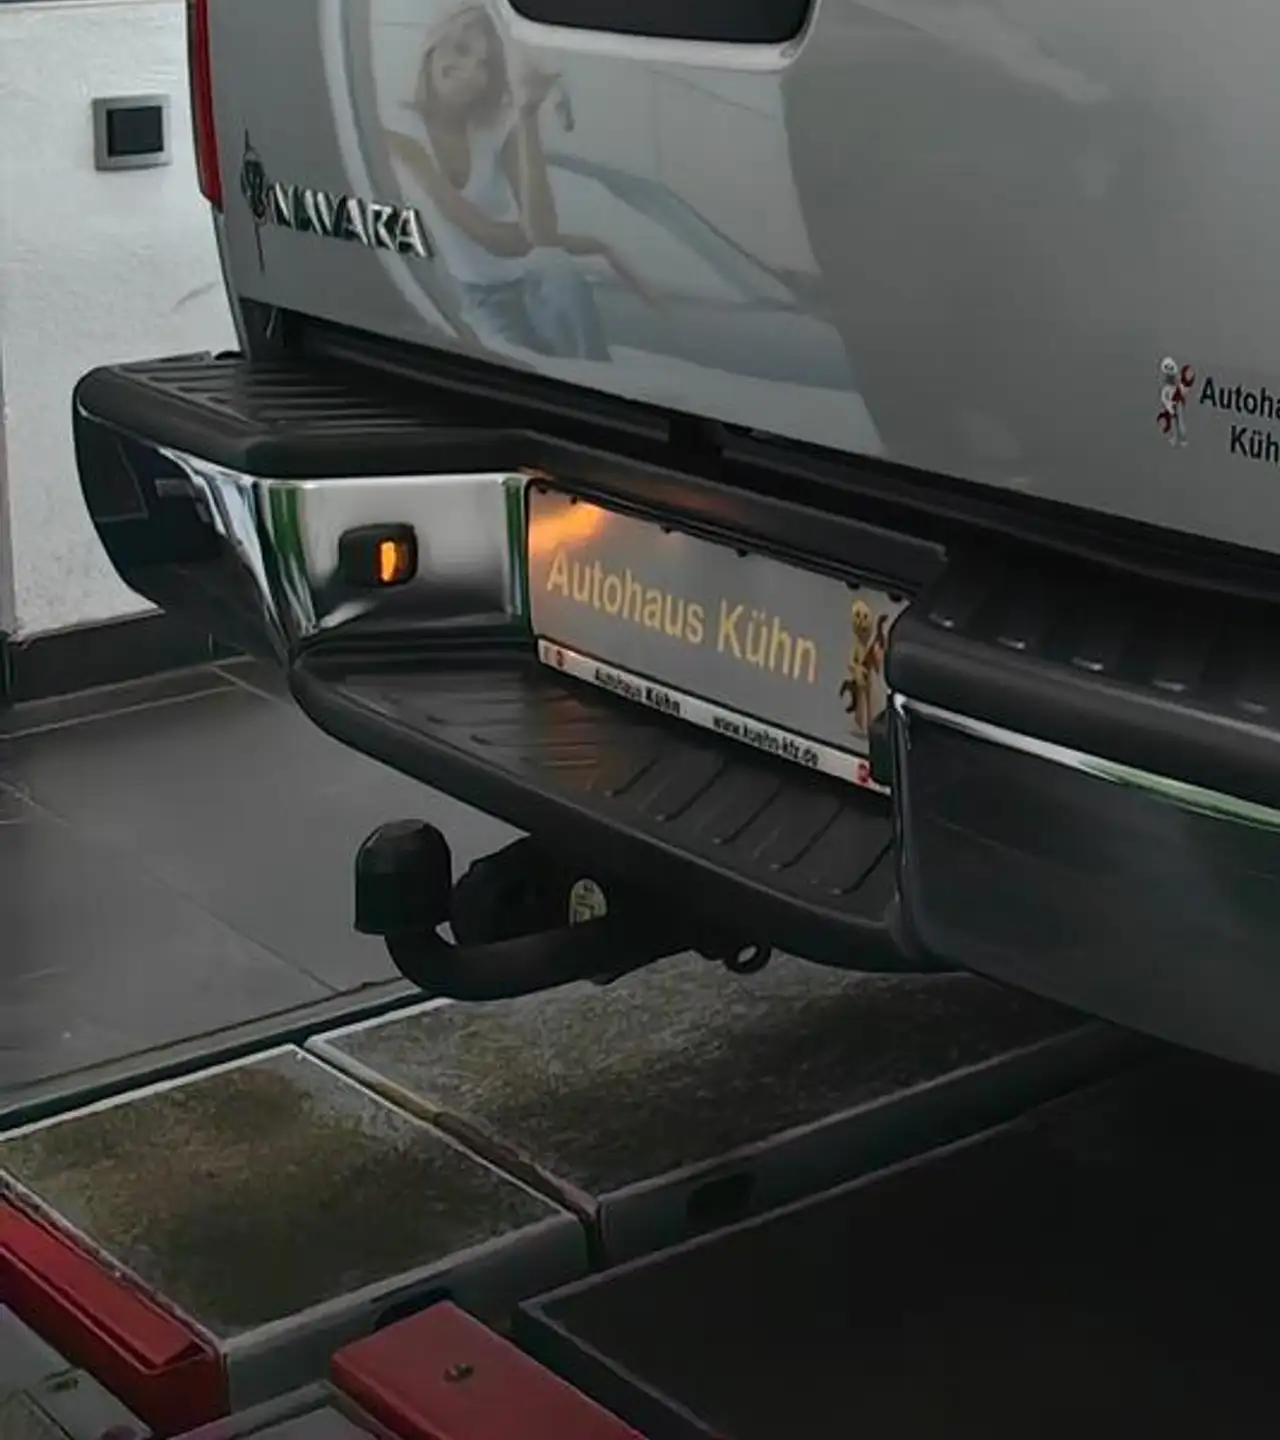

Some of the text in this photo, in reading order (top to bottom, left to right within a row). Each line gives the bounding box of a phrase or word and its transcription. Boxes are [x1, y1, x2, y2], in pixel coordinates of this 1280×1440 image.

[269, 180, 431, 258] NAVARA
[546, 551, 818, 685] Autohaus Kühn
[645, 685, 681, 716] Kühn
